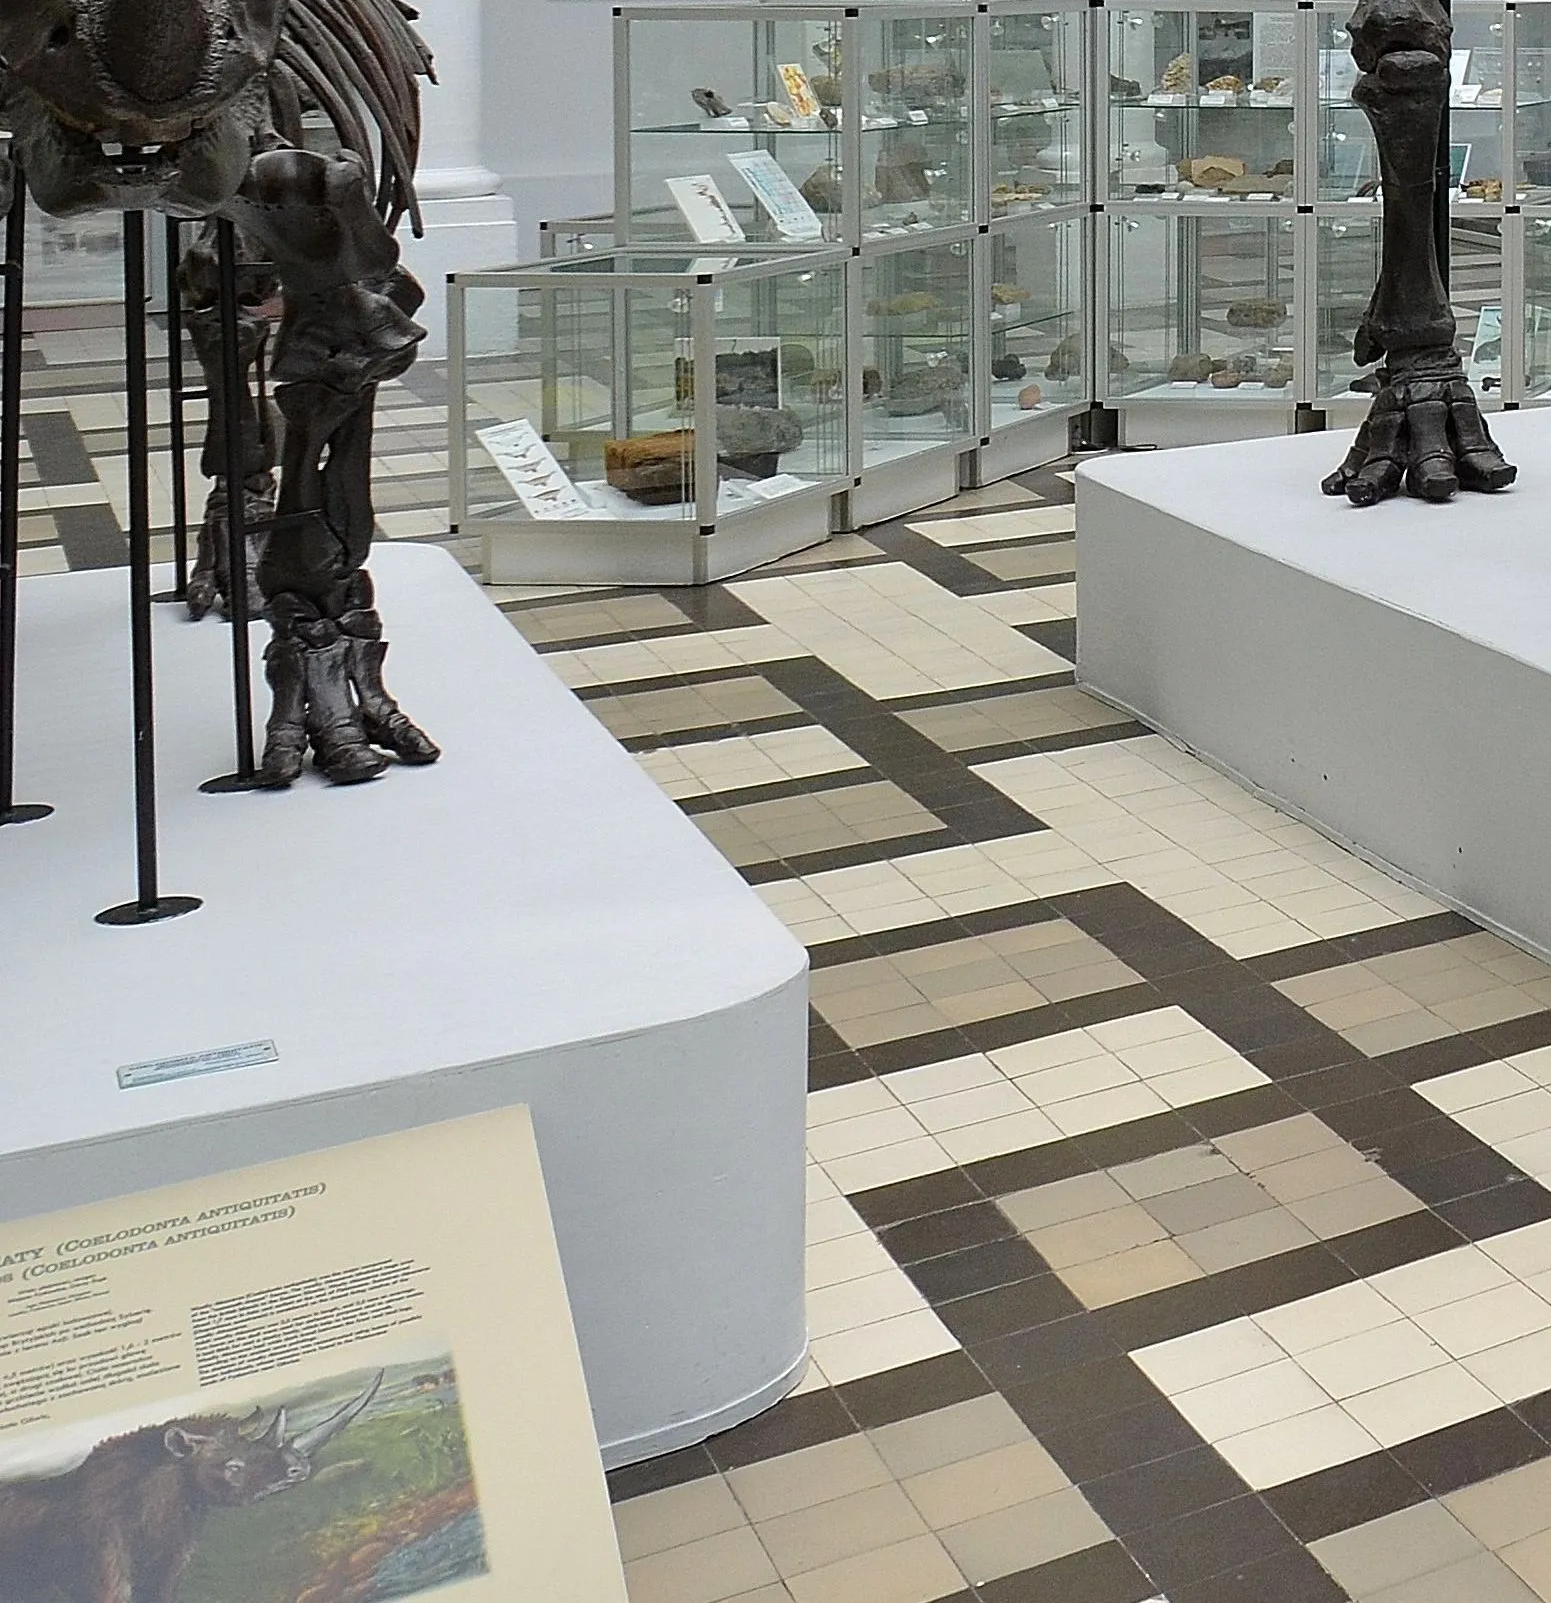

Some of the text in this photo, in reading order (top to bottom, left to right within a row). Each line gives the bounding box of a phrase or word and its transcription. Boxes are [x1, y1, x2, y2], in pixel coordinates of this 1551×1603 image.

[22, 1239, 158, 1281] (COELODONTA
[163, 1204, 296, 1247] ANTIQUITATIS)
[56, 1215, 191, 1256] (COELODONTA
[196, 1181, 326, 1223] ANTIQUITATIS)
